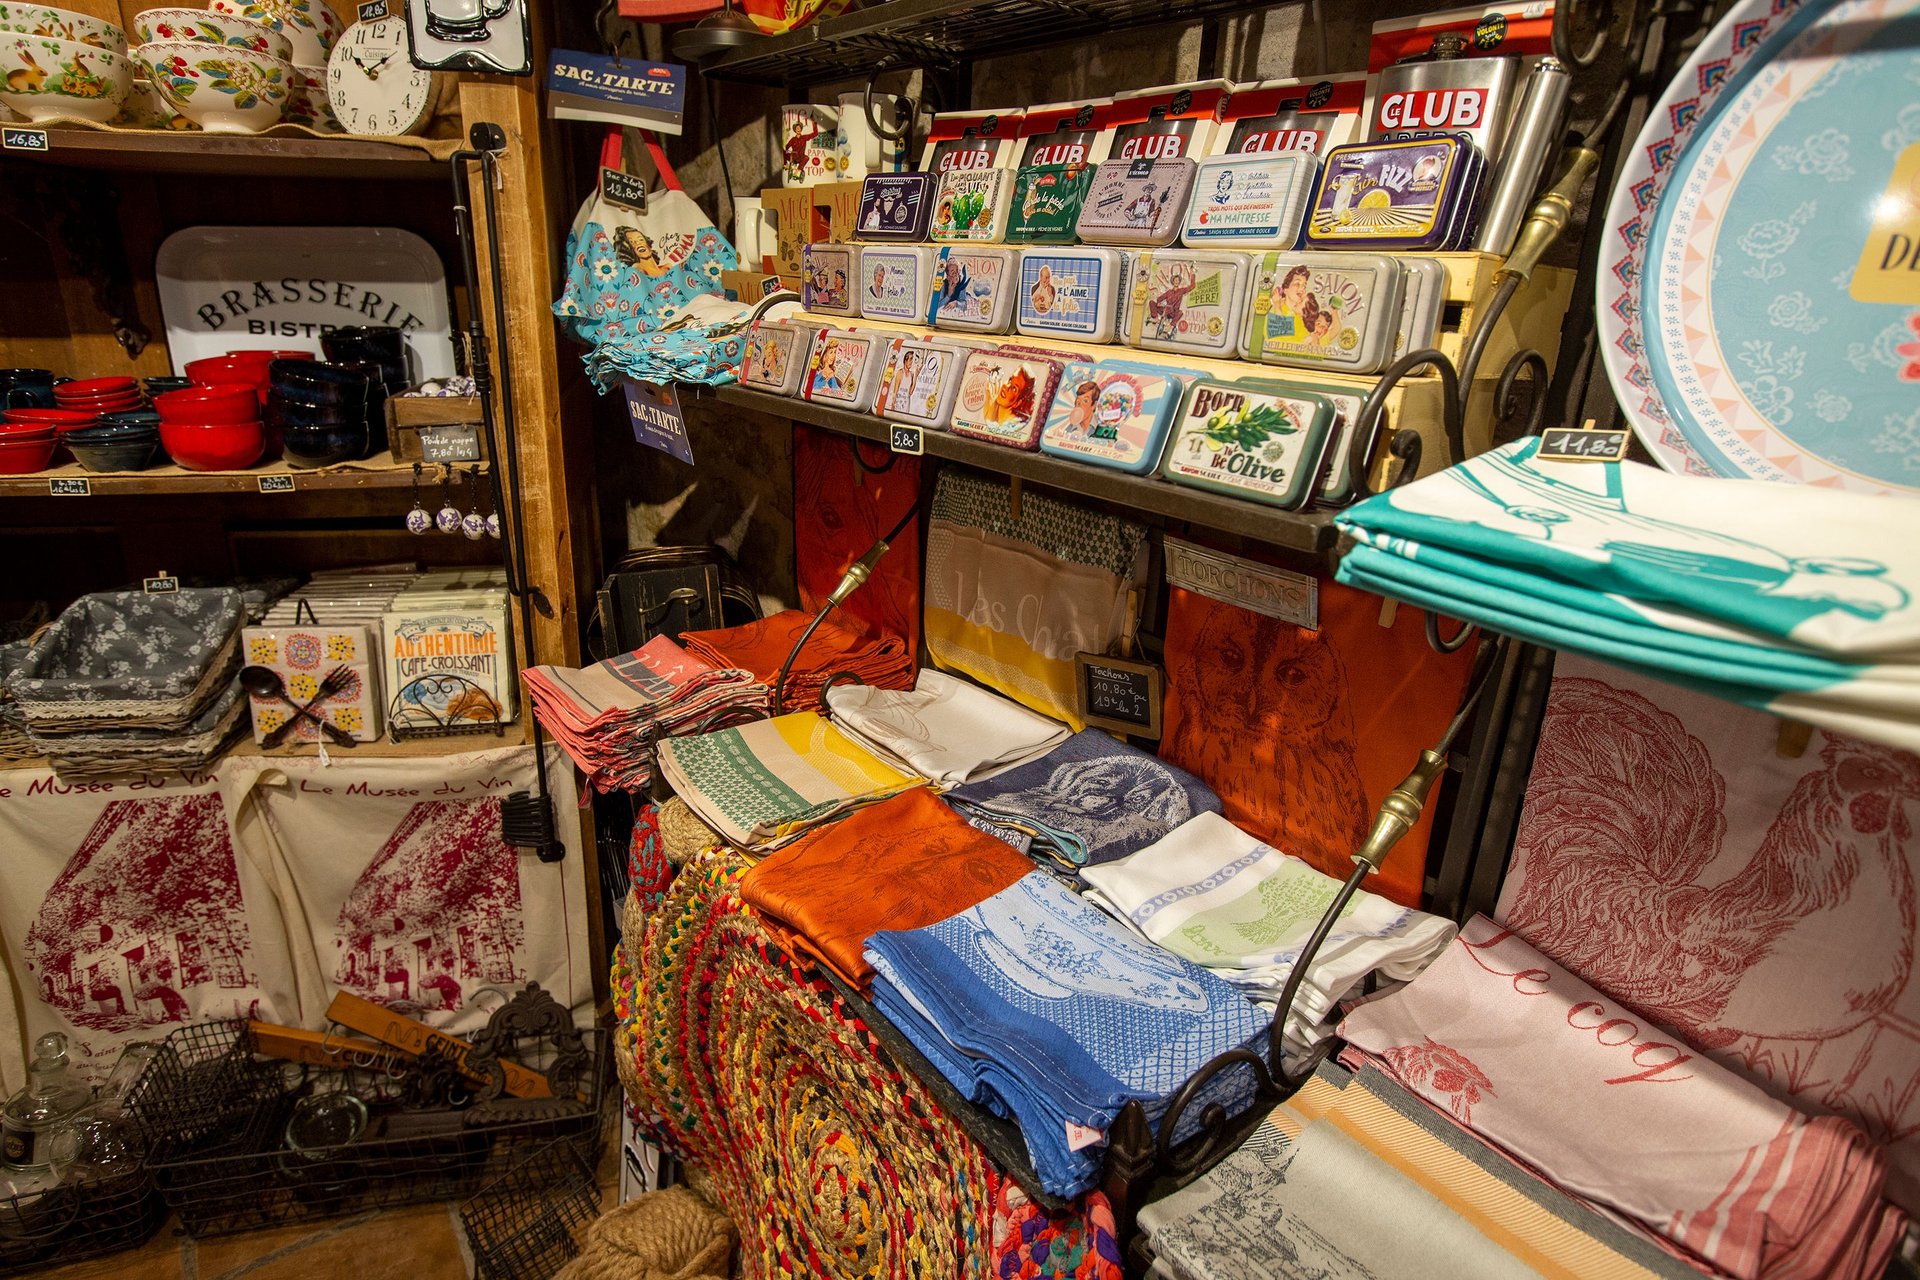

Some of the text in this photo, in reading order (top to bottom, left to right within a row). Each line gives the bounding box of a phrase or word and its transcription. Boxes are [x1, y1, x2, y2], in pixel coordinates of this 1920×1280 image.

[355, 29, 366, 44] 11
[371, 24, 386, 39] 12
[341, 46, 352, 61] 10
[333, 68, 341, 84] 9
[410, 70, 420, 87] 3
[554, 64, 594, 82] SAC
[602, 73, 675, 95] TARTE
[337, 90, 346, 107] 8
[401, 93, 412, 110] 4
[1381, 91, 1481, 128] CLUB
[351, 107, 359, 123] 7
[368, 114, 377, 131] 6
[387, 109, 398, 126] 5
[1120, 136, 1181, 159] CLUB
[1241, 131, 1318, 154] CLUB
[939, 151, 990, 172] CLUB
[1032, 146, 1085, 166] CLUB
[1378, 164, 1413, 193] FIZZ
[1209, 214, 1222, 224] MA
[1313, 272, 1365, 316] SAVON
[197, 277, 425, 341] BRASSERIE
[1191, 388, 1246, 418] Born
[630, 400, 682, 435] SAC TARTE
[1549, 433, 1622, 456] 11,80€
[1211, 452, 1286, 484] Be Olive
[1178, 556, 1301, 609] TORCHONS
[394, 631, 498, 658] AUTHENTIQUE
[401, 654, 491, 677] CAFÉ-CROISSANT
[1134, 704, 1142, 717] 2
[27, 775, 114, 797] Musée
[128, 773, 165, 790] du
[181, 769, 219, 785] Vin
[300, 775, 512, 798] Le Musée du Vin
[1567, 1001, 1694, 1086] coq
